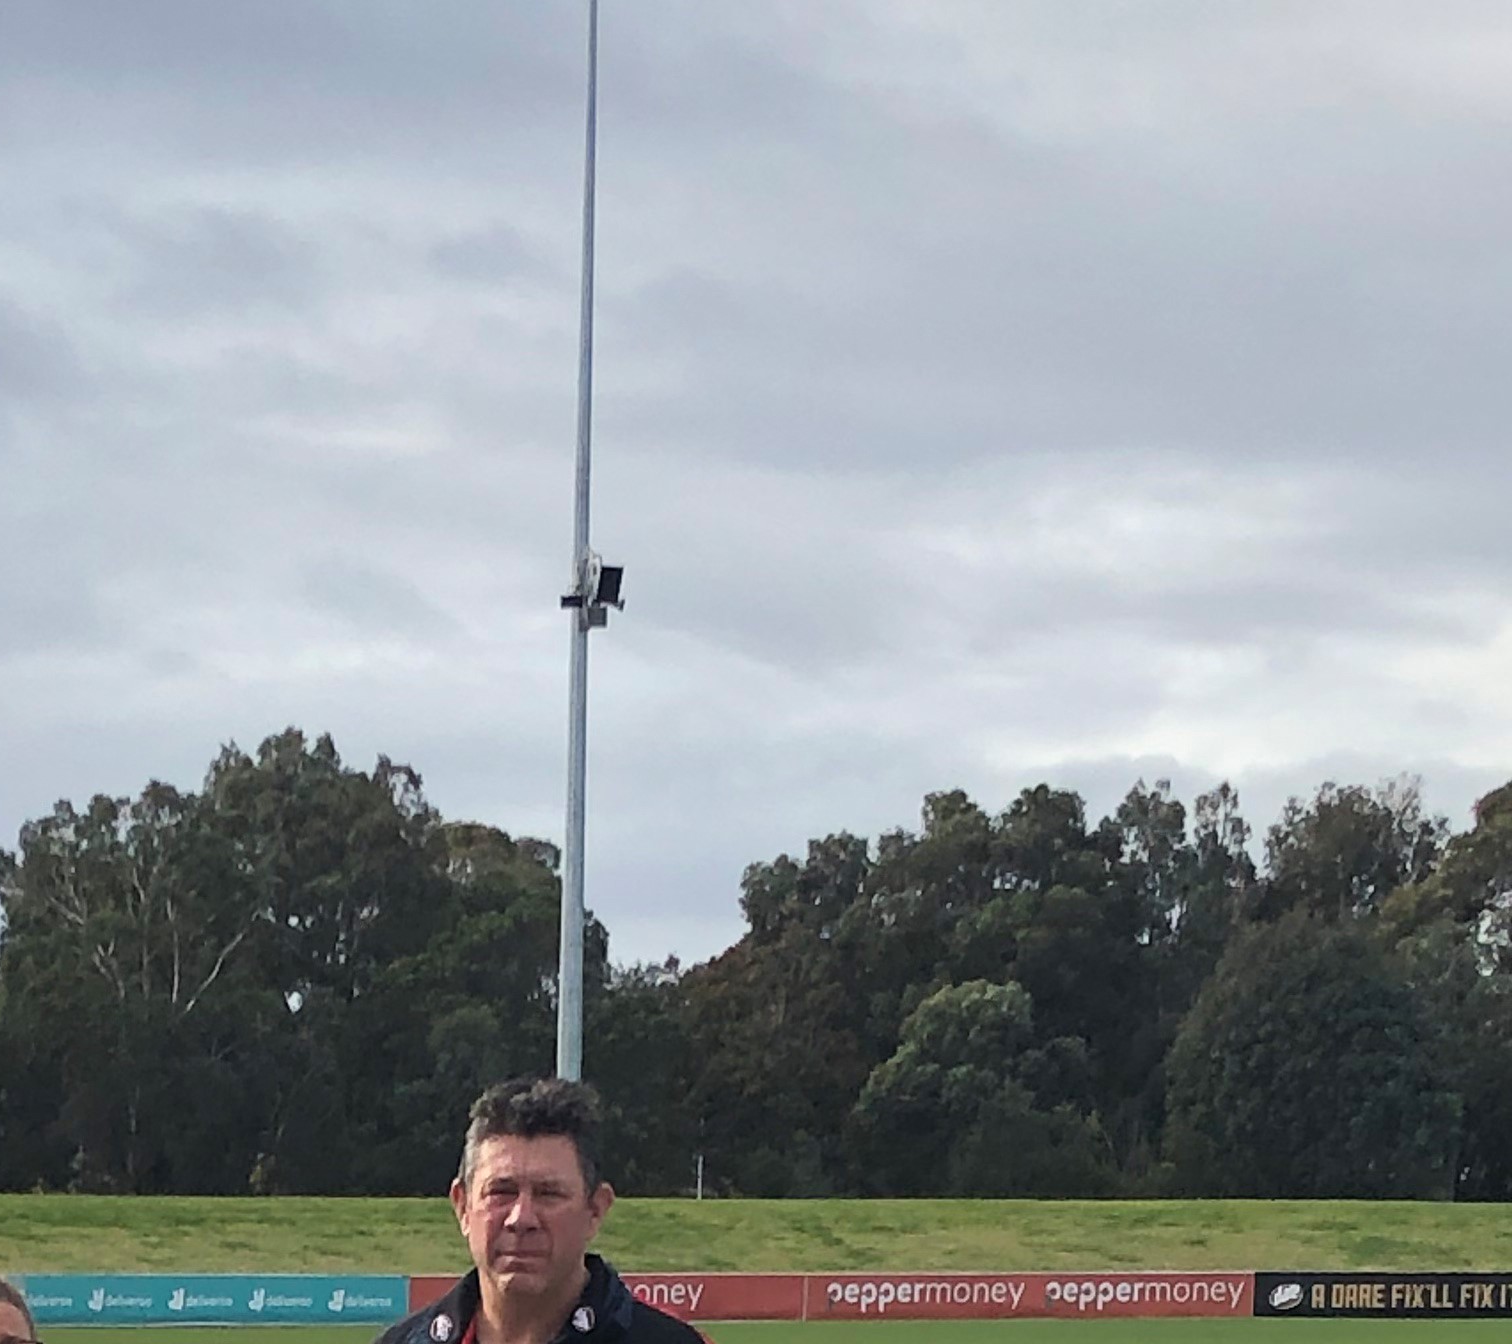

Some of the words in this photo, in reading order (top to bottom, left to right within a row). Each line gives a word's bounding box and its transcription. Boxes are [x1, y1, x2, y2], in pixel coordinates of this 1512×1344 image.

[826, 1282, 1025, 1312] peppermoney
[1044, 1281, 1245, 1310] peppermoney
[1311, 1284, 1325, 1309] A
[1331, 1284, 1386, 1309] DARE
[1460, 1284, 1495, 1309] FIX
